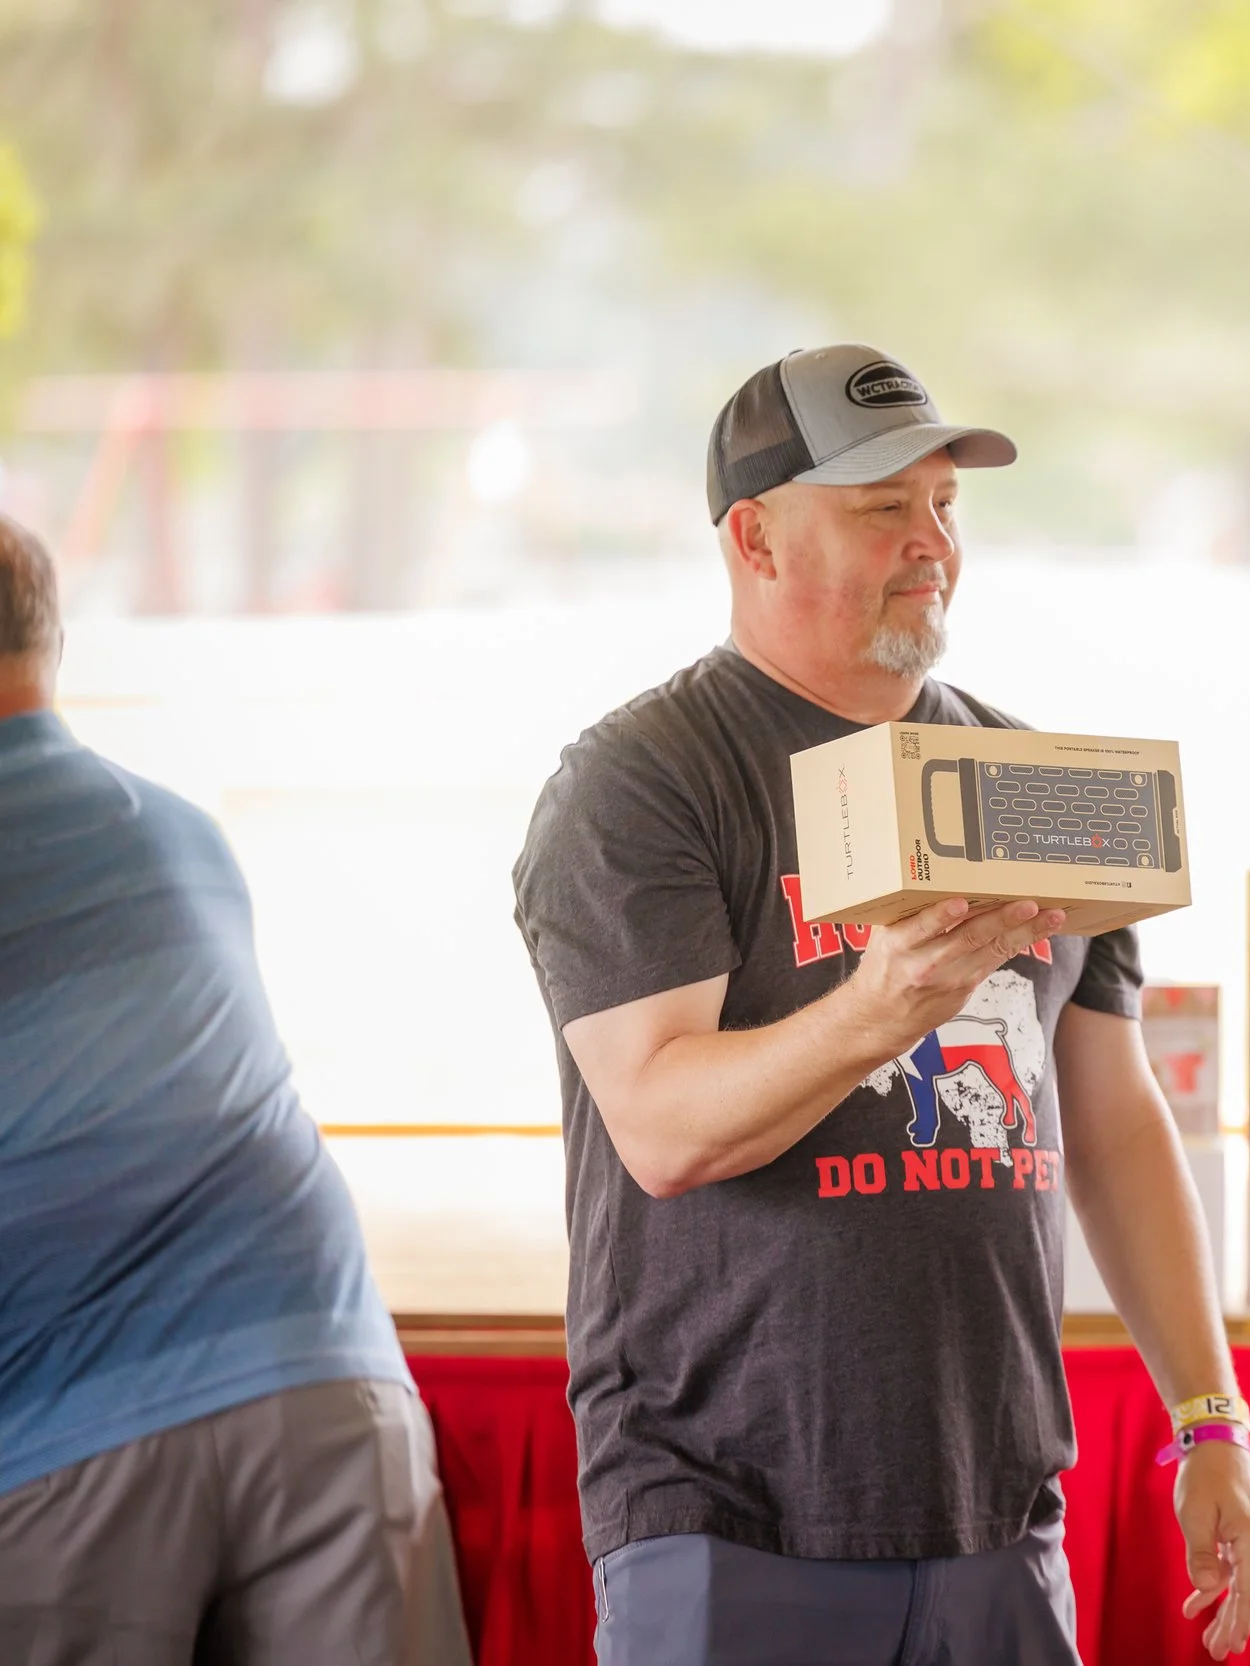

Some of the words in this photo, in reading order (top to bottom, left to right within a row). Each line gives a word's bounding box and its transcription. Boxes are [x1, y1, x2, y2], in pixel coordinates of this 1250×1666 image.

[837, 764, 854, 880] TURTLEBOX
[1033, 833, 1111, 848] TURTLEBOX
[915, 839, 924, 881] OUTDOOR
[923, 853, 931, 882] AUDIO
[815, 1153, 886, 1198] DO
[902, 1147, 1000, 1192] NOT
[1011, 1147, 1060, 1191] PET
